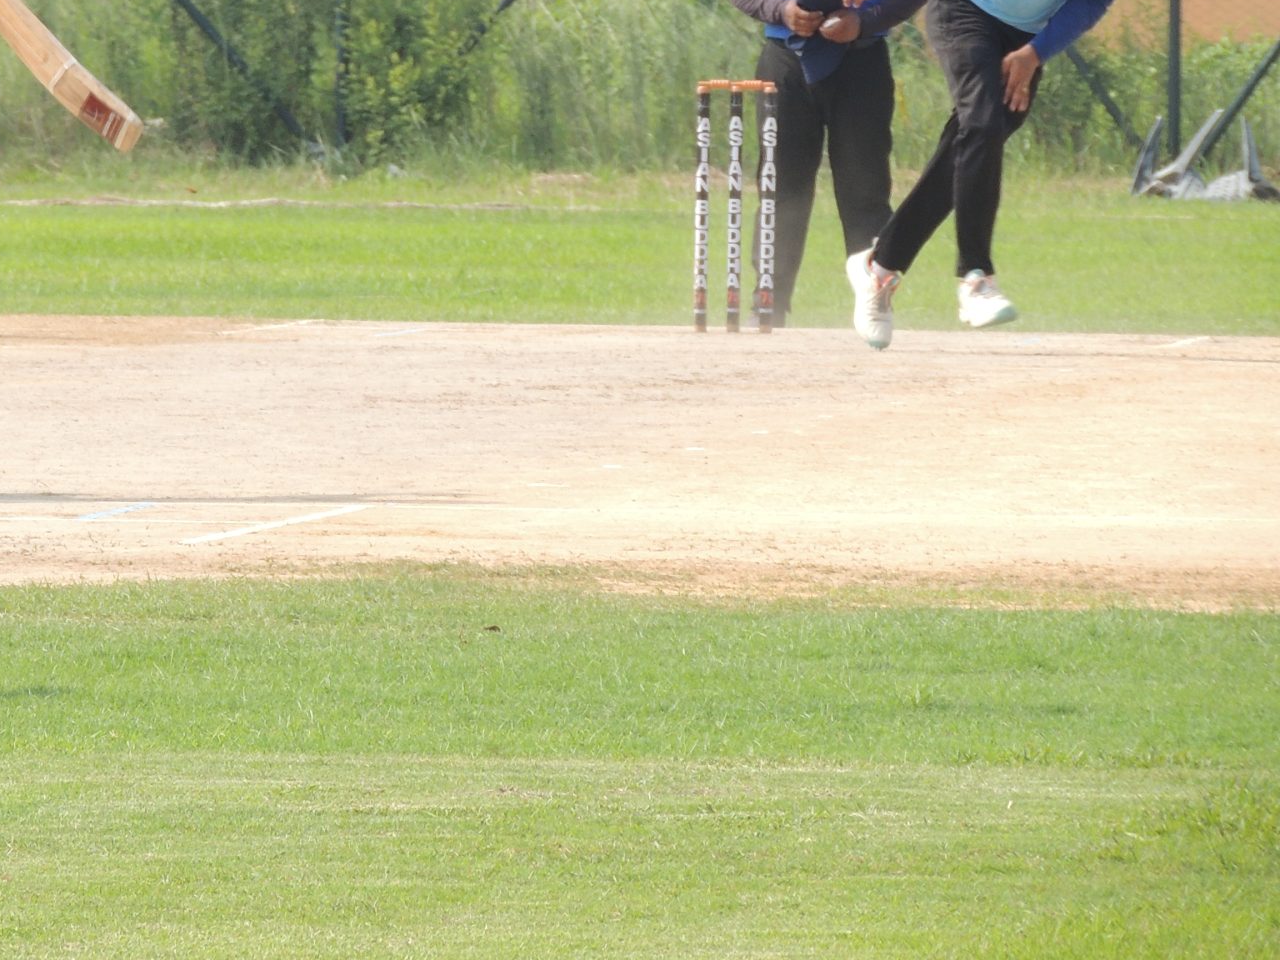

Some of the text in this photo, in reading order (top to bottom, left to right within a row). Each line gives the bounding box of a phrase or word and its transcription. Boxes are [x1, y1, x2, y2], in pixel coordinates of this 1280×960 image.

[696, 116, 711, 192] ASIAN
[728, 115, 743, 192] ASIAN
[761, 116, 777, 192] ASIAN
[694, 200, 709, 289] BUDDHA
[726, 198, 742, 288] BUDDHA
[759, 199, 775, 289] BUDDHA
